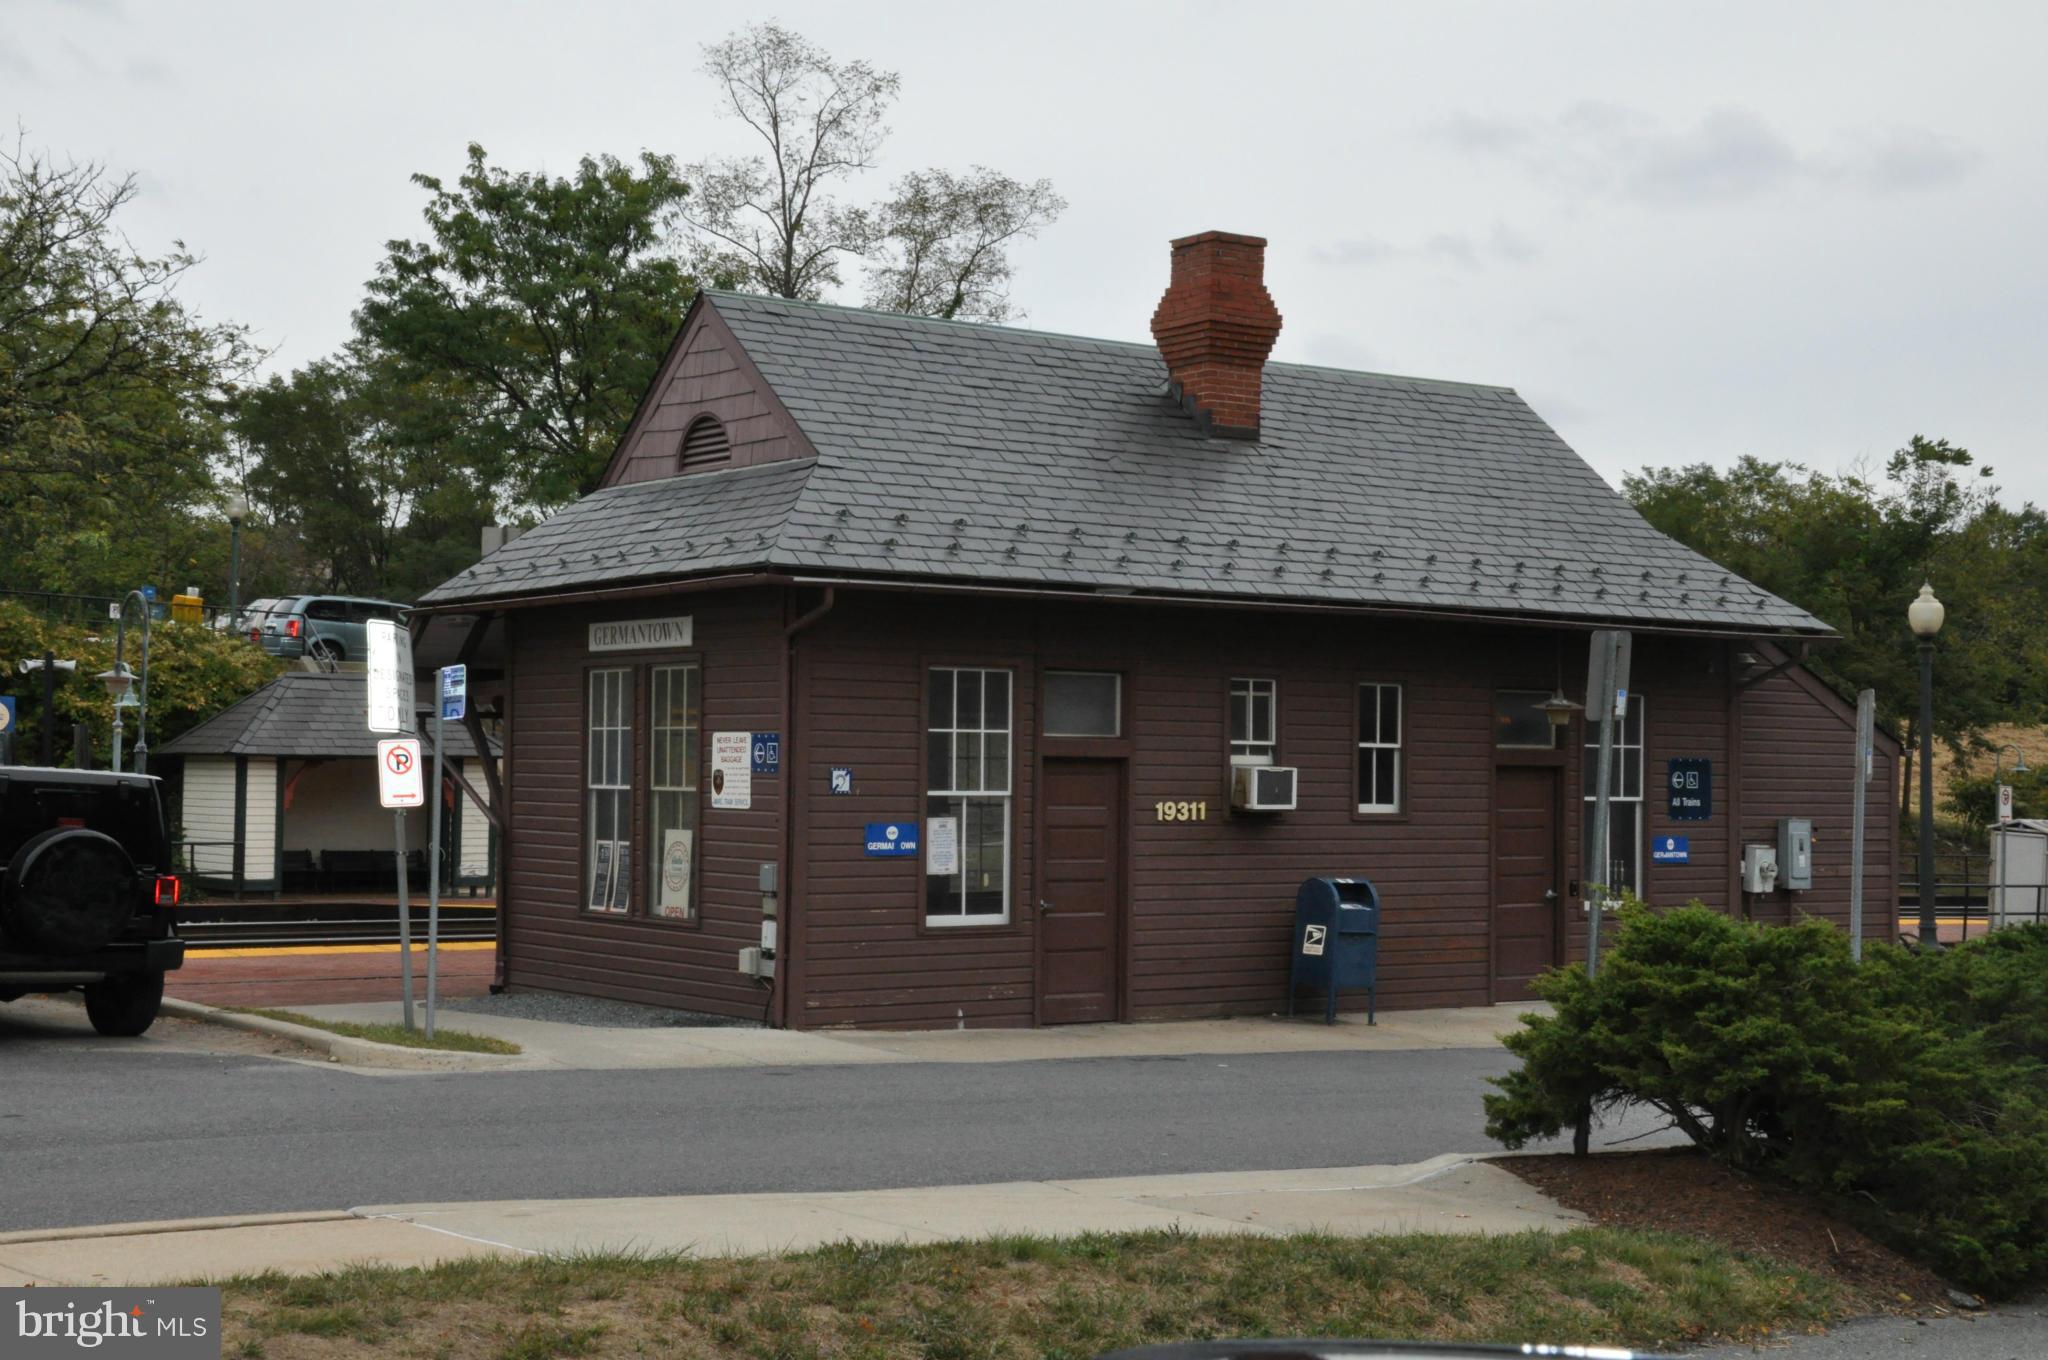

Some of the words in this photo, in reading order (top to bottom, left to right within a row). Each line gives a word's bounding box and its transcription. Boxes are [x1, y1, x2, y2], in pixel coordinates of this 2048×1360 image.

[593, 621, 684, 646] GERMANTOWN
[1672, 797, 1680, 806] All
[1682, 797, 1701, 807] Trains
[1155, 801, 1206, 821] 19311
[665, 905, 684, 919] OPEN
